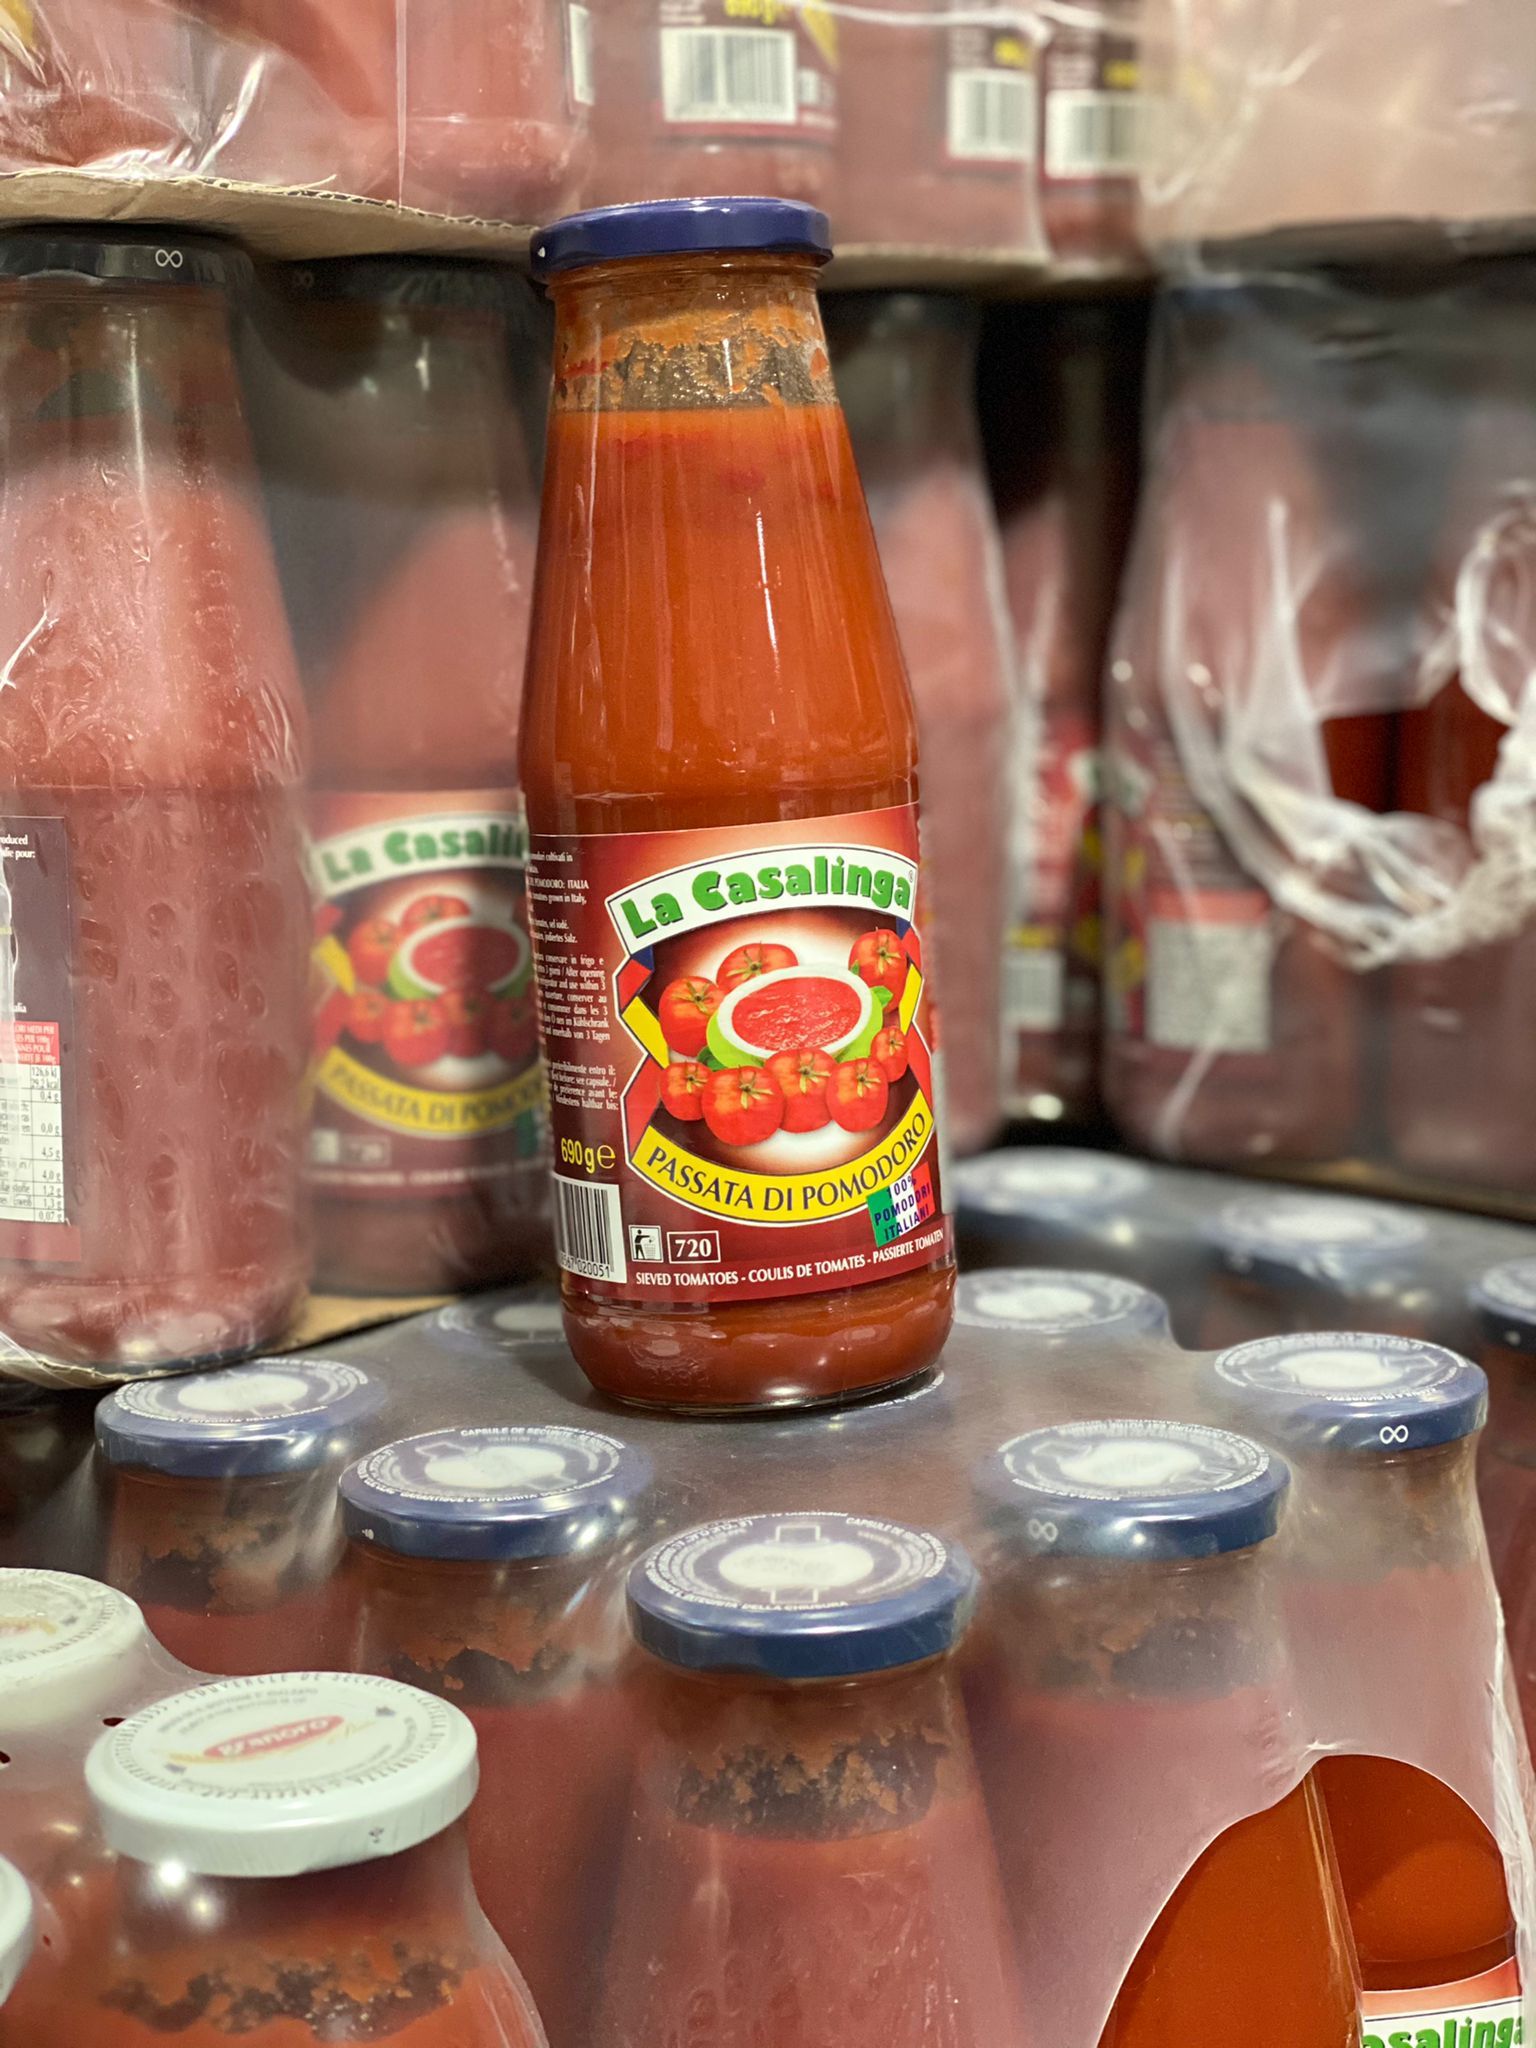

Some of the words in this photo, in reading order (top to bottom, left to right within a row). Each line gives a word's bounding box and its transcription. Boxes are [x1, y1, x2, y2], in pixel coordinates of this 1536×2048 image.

[0, 833, 28, 845] oduced
[567, 880, 589, 890] ITALIA
[620, 892, 684, 938] La
[691, 855, 911, 911] Casalinga
[601, 981, 606, 991] 3
[598, 995, 607, 1003] au
[603, 1005, 608, 1016] 3
[591, 1030, 611, 1043] Tagen
[588, 1065, 606, 1075] entro
[646, 1146, 754, 1209] PASSATA
[763, 1187, 793, 1211] DI
[802, 1112, 926, 1210] POMODORO
[886, 1174, 918, 1199] 100%
[874, 1182, 930, 1226] POMODORI
[884, 1203, 930, 1241] ITALIANI
[674, 1238, 712, 1258] 720
[576, 1259, 610, 1279] 020051
[636, 1271, 672, 1285] SIEVED
[673, 1270, 739, 1286] TOMATOES
[748, 1266, 794, 1283] COULIS
[796, 1262, 812, 1278] DE
[815, 1254, 866, 1275] TOMATES
[873, 1238, 914, 1264] PASSIERTE
[461, 1427, 509, 1437] CAPSULE
[740, 1601, 783, 1611] DELLA
[184, 1672, 291, 1700] COUVERCLE
